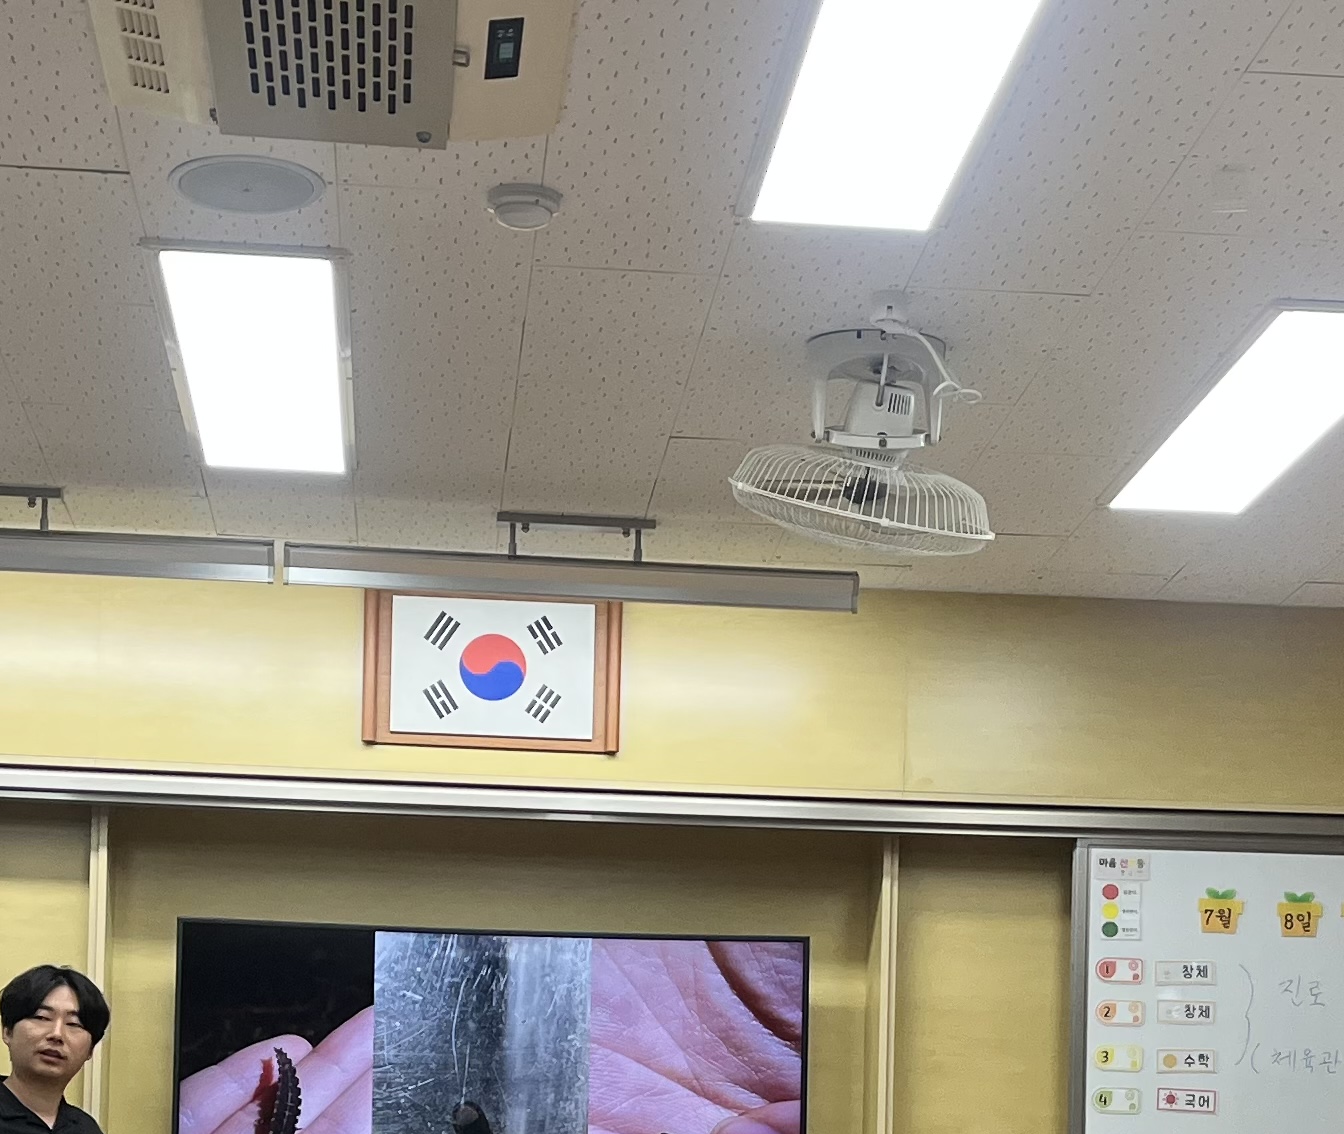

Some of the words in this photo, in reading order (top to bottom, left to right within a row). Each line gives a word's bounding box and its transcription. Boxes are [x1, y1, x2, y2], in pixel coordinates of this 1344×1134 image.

[1203, 908, 1232, 929] 7월
[1283, 911, 1312, 932] 8일
[1278, 974, 1326, 1008] 진로
[1103, 1005, 1111, 1018] 2
[1100, 1050, 1109, 1064] 3
[1184, 1053, 1210, 1068] 수학
[1098, 1093, 1108, 1106] 4
[1184, 1093, 1211, 1109] 국어
